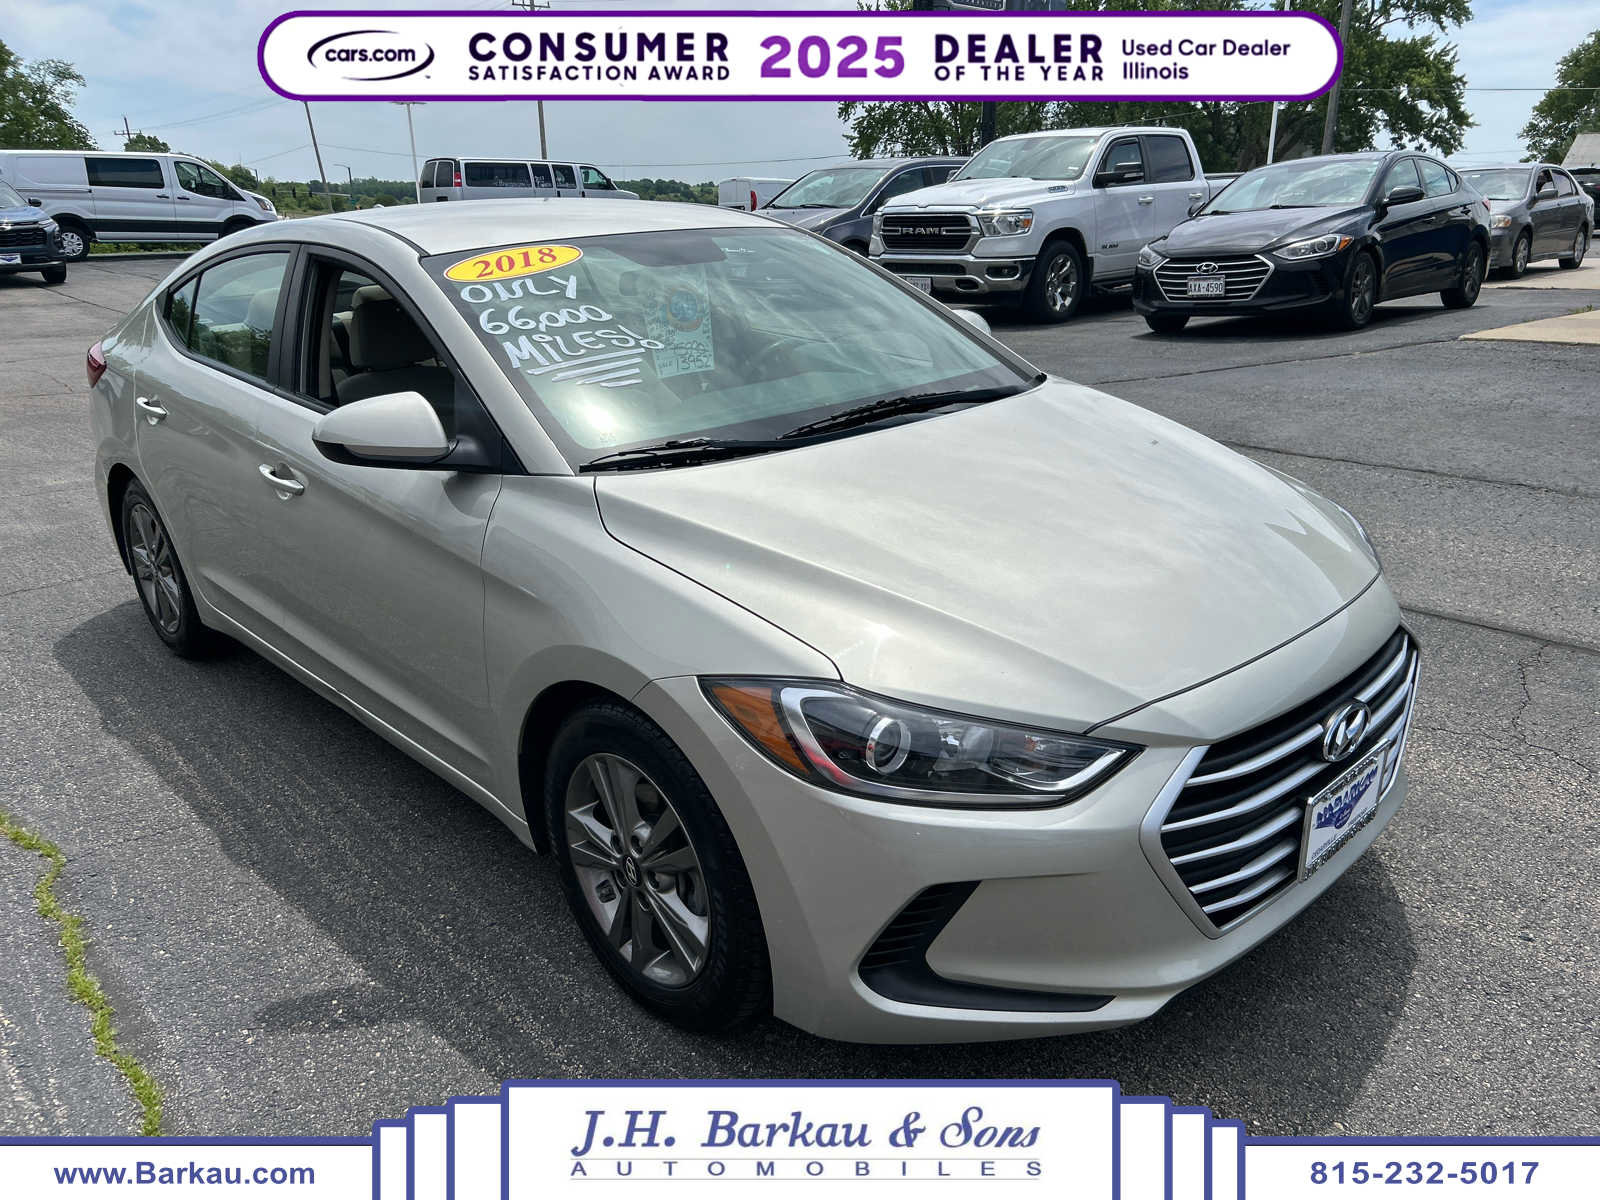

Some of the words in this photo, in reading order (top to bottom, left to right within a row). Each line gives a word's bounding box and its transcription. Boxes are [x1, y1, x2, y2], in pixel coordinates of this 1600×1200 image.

[902, 227, 940, 235] RAM
[473, 247, 557, 278] 2018
[460, 275, 577, 303] ONLY
[479, 305, 613, 335] 66,000
